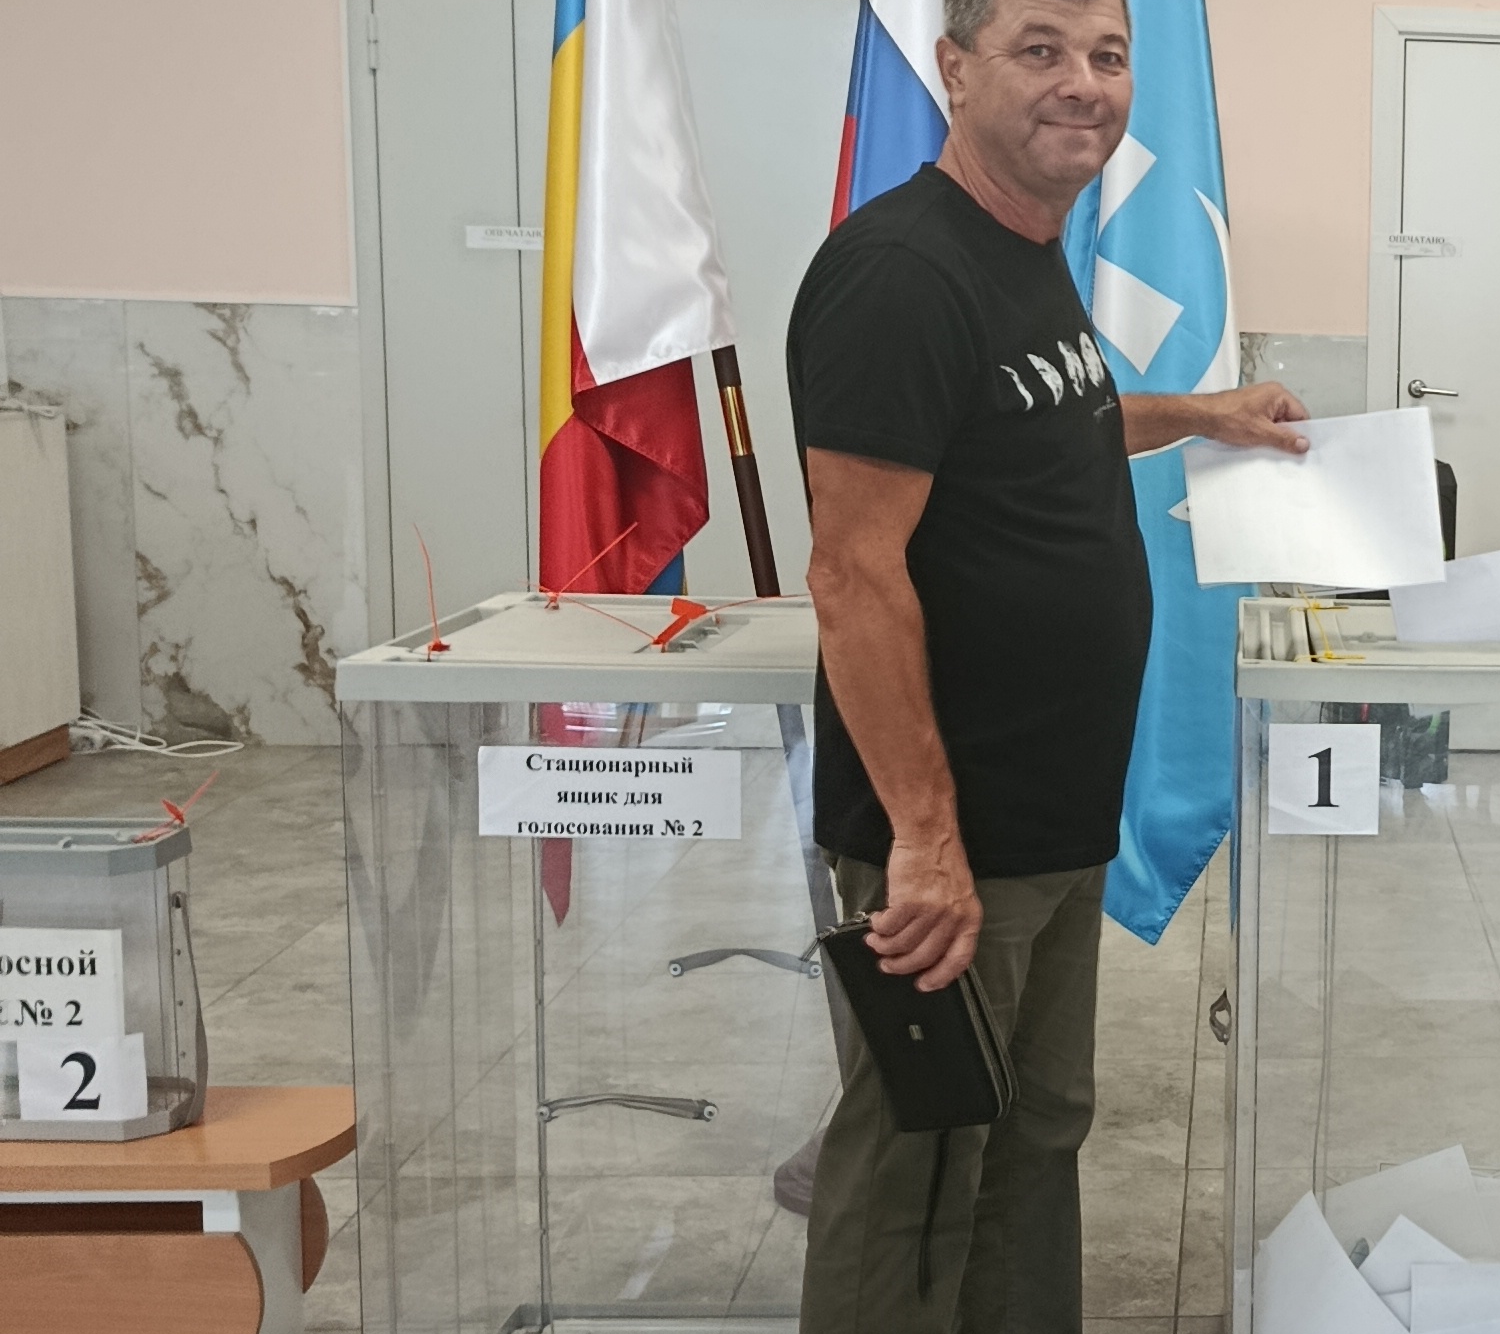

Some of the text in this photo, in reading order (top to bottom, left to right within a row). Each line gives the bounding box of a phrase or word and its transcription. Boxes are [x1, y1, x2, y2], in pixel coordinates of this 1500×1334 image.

[1388, 235, 1445, 244] ОПЕЧАТАНО
[526, 753, 693, 777] Стационарный
[1308, 747, 1339, 807] 1
[557, 791, 662, 806] ящик для
[517, 819, 703, 836] голосования № 2
[14, 999, 53, 1026] №
[65, 1000, 83, 1026] 2
[61, 1052, 101, 1110] 2
